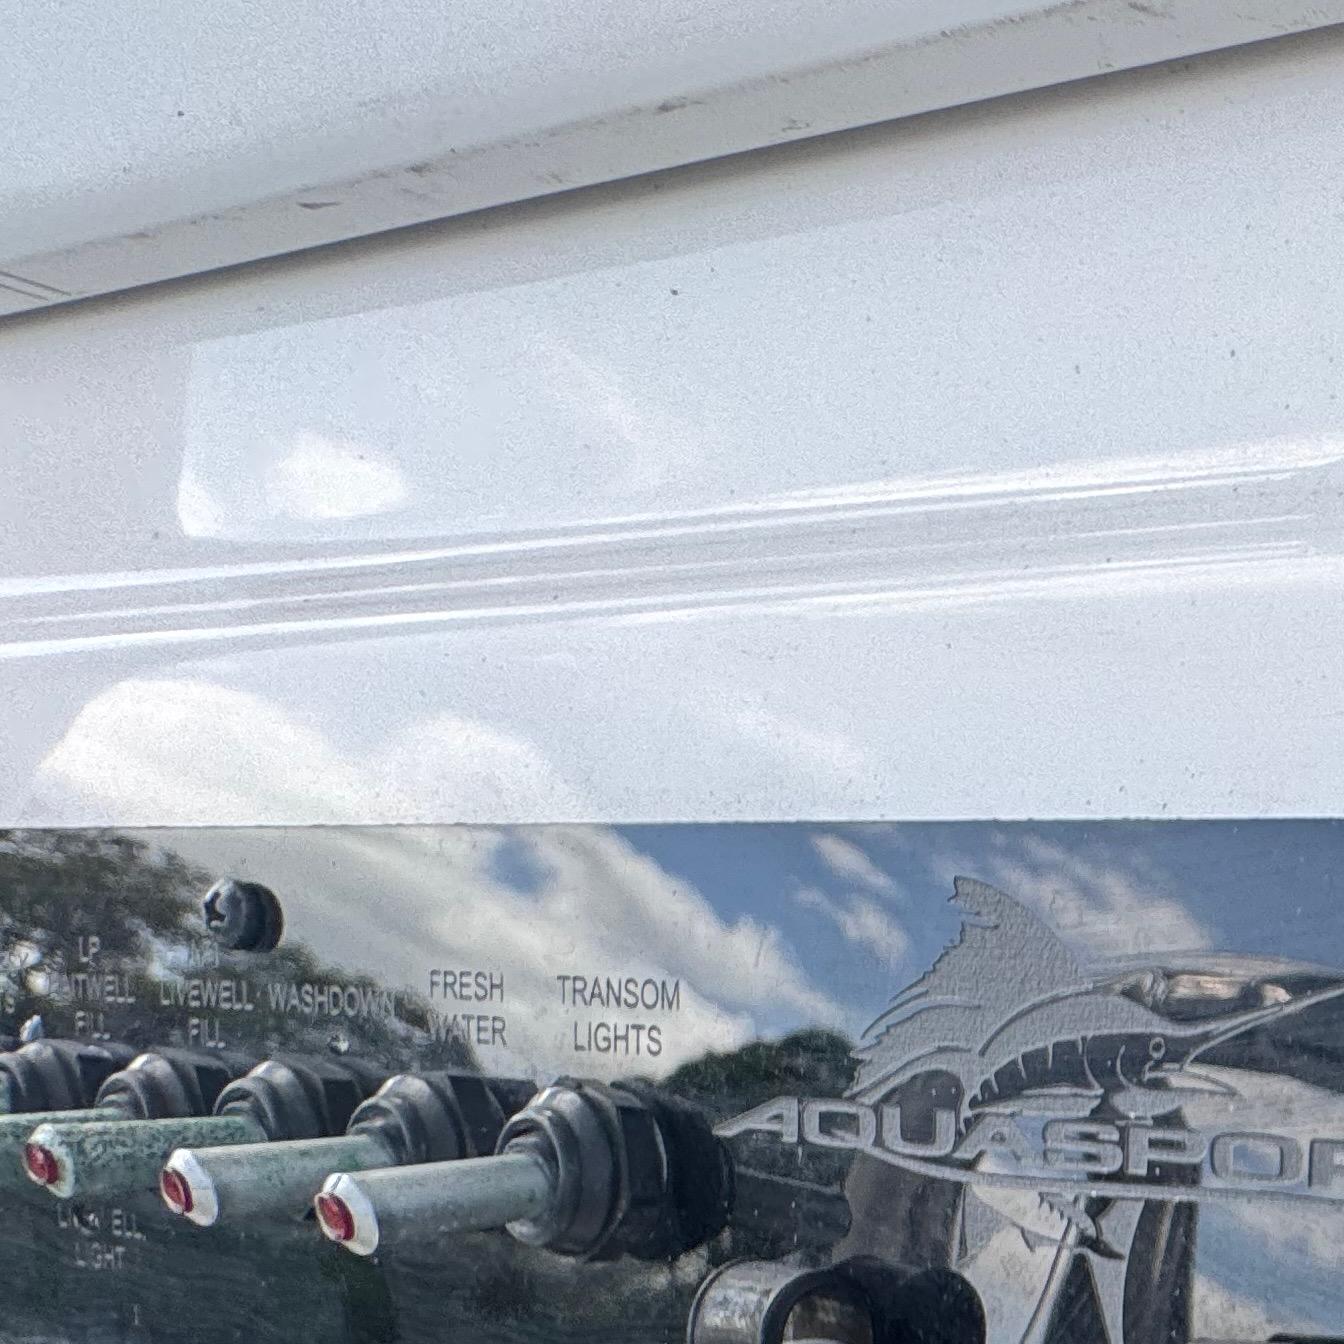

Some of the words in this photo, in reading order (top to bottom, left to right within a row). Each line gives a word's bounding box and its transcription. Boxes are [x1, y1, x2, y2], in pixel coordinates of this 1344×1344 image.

[429, 968, 505, 1003] FRESH
[556, 974, 681, 1011] TRANSOM
[427, 1012, 508, 1048] WATER
[573, 1020, 663, 1057] LIGHTS
